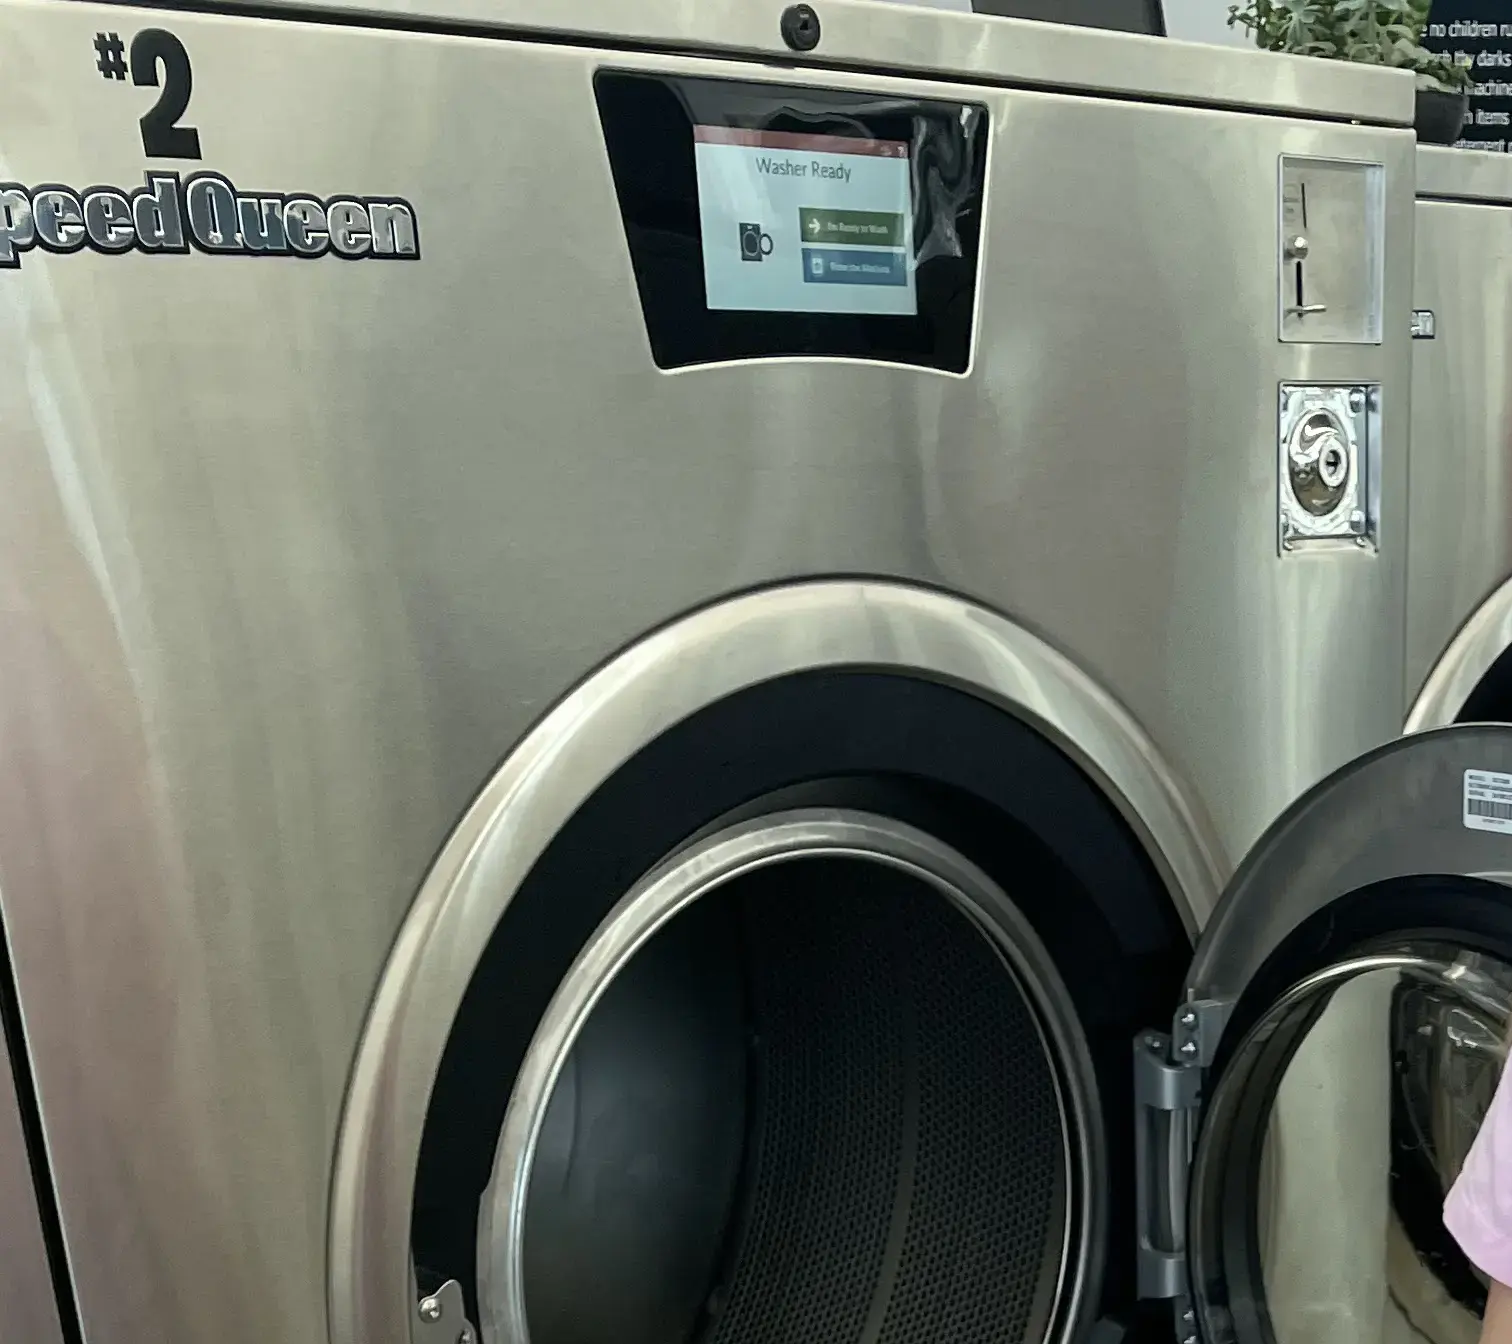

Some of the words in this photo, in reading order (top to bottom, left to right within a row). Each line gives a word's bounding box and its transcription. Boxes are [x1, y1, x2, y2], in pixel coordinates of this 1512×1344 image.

[1429, 23, 1447, 38] no
[1448, 20, 1498, 38] children
[1476, 50, 1512, 68] darks
[93, 27, 202, 160] #2
[1475, 108, 1510, 126] items
[755, 156, 808, 177] Washer
[811, 160, 852, 184] Ready
[0, 169, 421, 270] peedQueen
